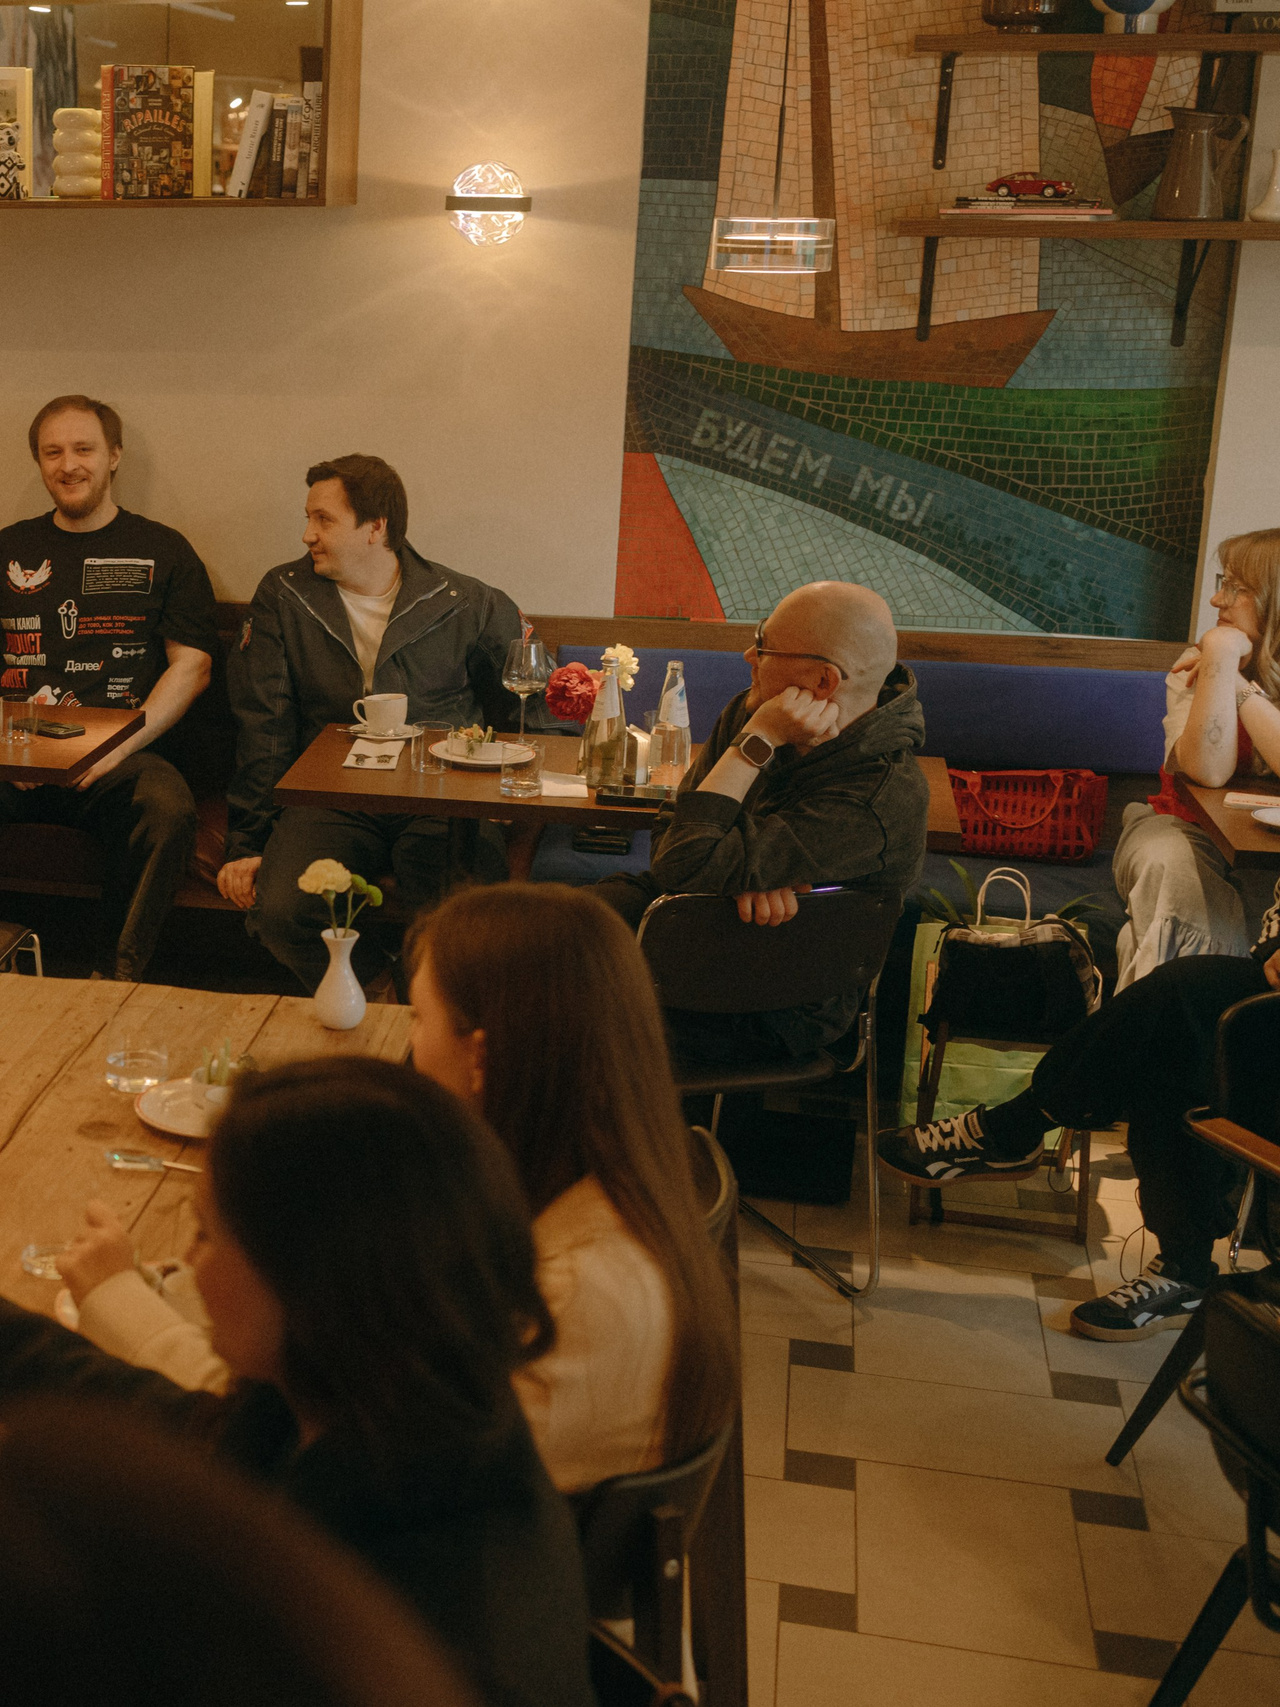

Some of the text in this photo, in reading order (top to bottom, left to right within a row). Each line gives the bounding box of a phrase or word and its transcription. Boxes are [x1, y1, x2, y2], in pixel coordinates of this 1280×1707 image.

[1253, 16, 1280, 30] VO
[102, 91, 111, 180] RIPAILLES
[123, 109, 186, 132] RIPAILLES
[312, 94, 322, 153] ARCHITECTURE
[691, 408, 934, 527] БУДЕМ МЫ
[16, 615, 41, 631] КАКОЙ
